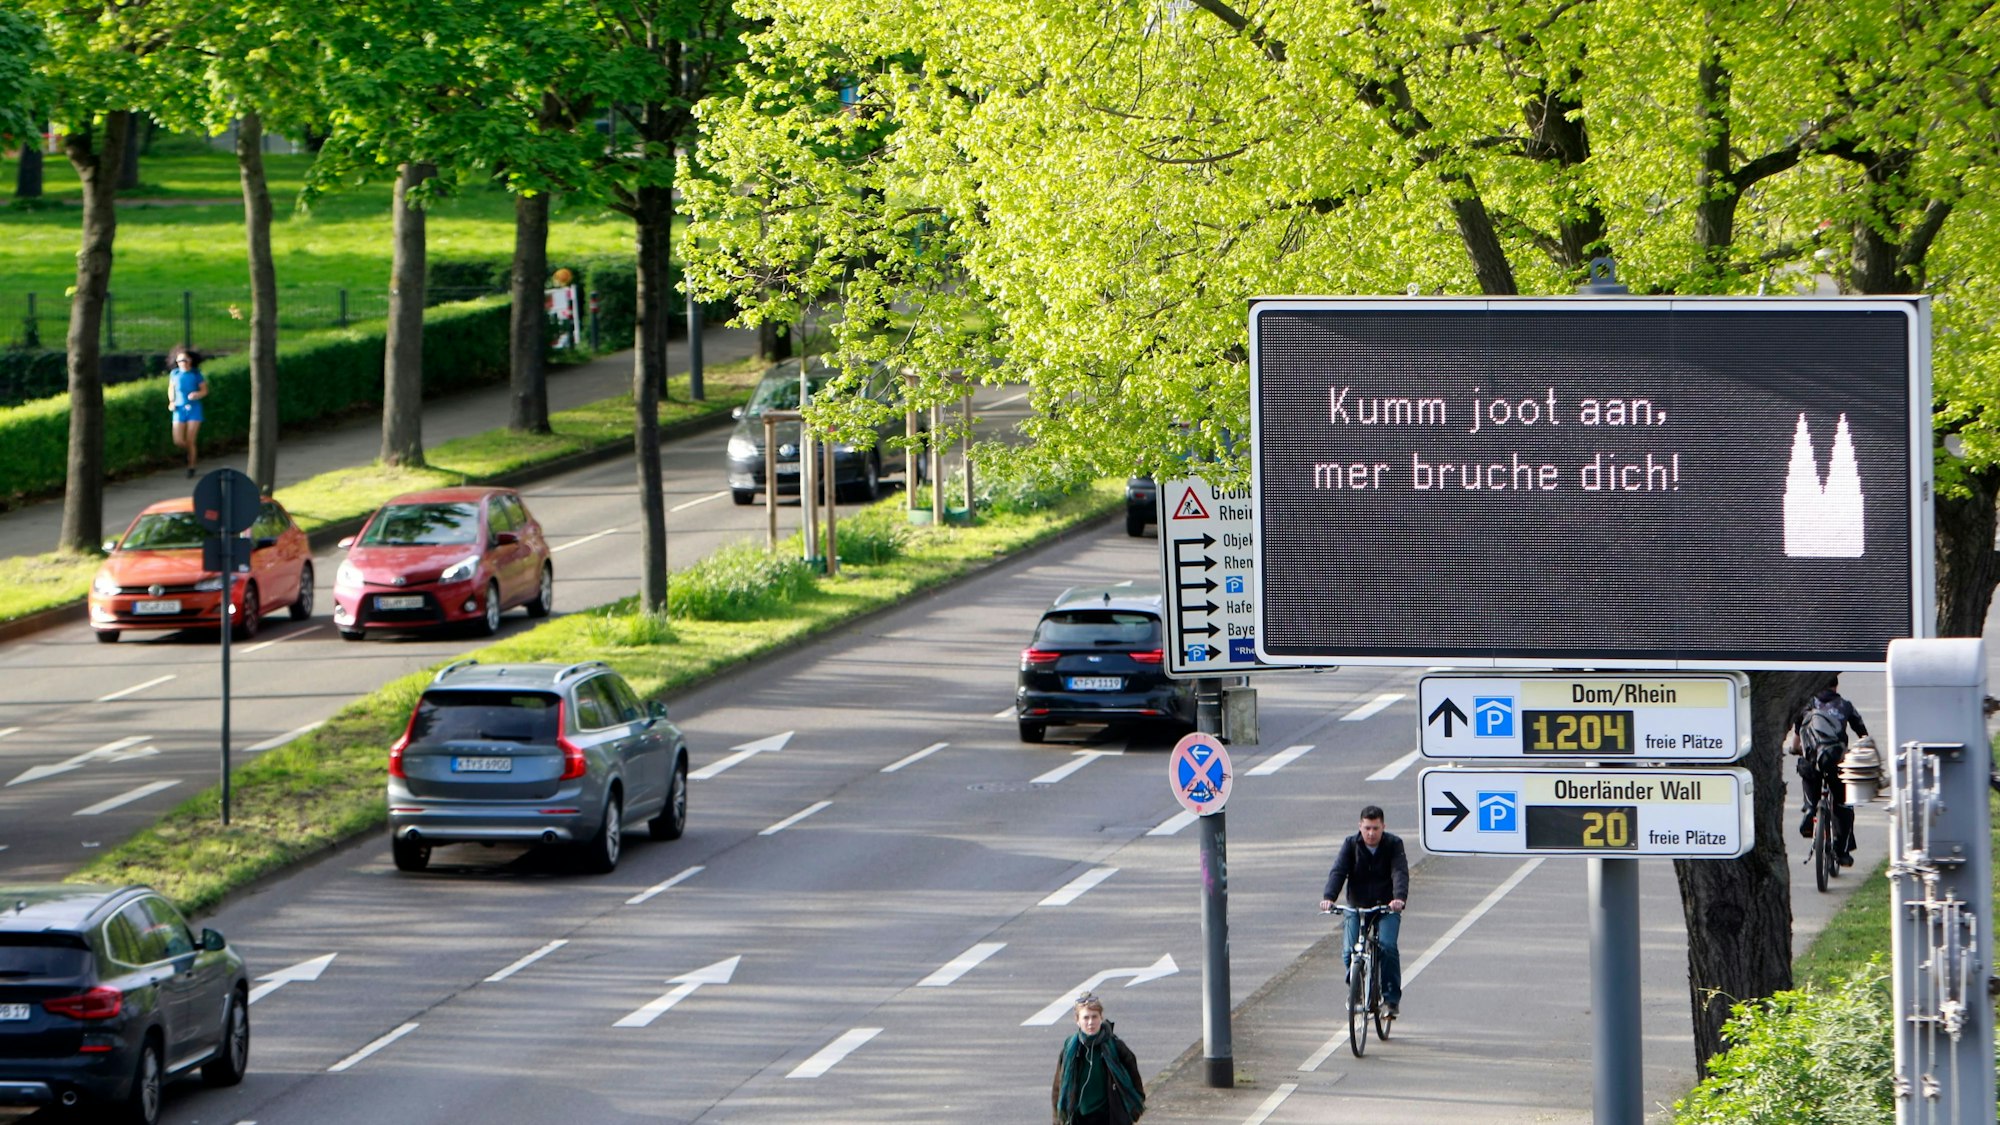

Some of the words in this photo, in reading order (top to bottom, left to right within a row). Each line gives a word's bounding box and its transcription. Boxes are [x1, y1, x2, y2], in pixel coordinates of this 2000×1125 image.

[1329, 387, 1447, 425] Kumm
[1470, 387, 1559, 434] joot
[1579, 398, 1667, 426] aan,
[1314, 462, 1389, 490] mer
[1413, 453, 1558, 491] bruche
[1580, 453, 1680, 491] dich!
[1572, 683, 1676, 706] Dom/Rhein
[1533, 715, 1625, 750] 1204
[1645, 735, 1677, 749] freie
[1682, 734, 1723, 749] Plätze
[1554, 779, 1654, 800] Oberländer
[1660, 780, 1701, 801] Wall
[1583, 812, 1629, 847] 20
[1649, 829, 1680, 845] freie
[1685, 830, 1726, 845] Plätze
